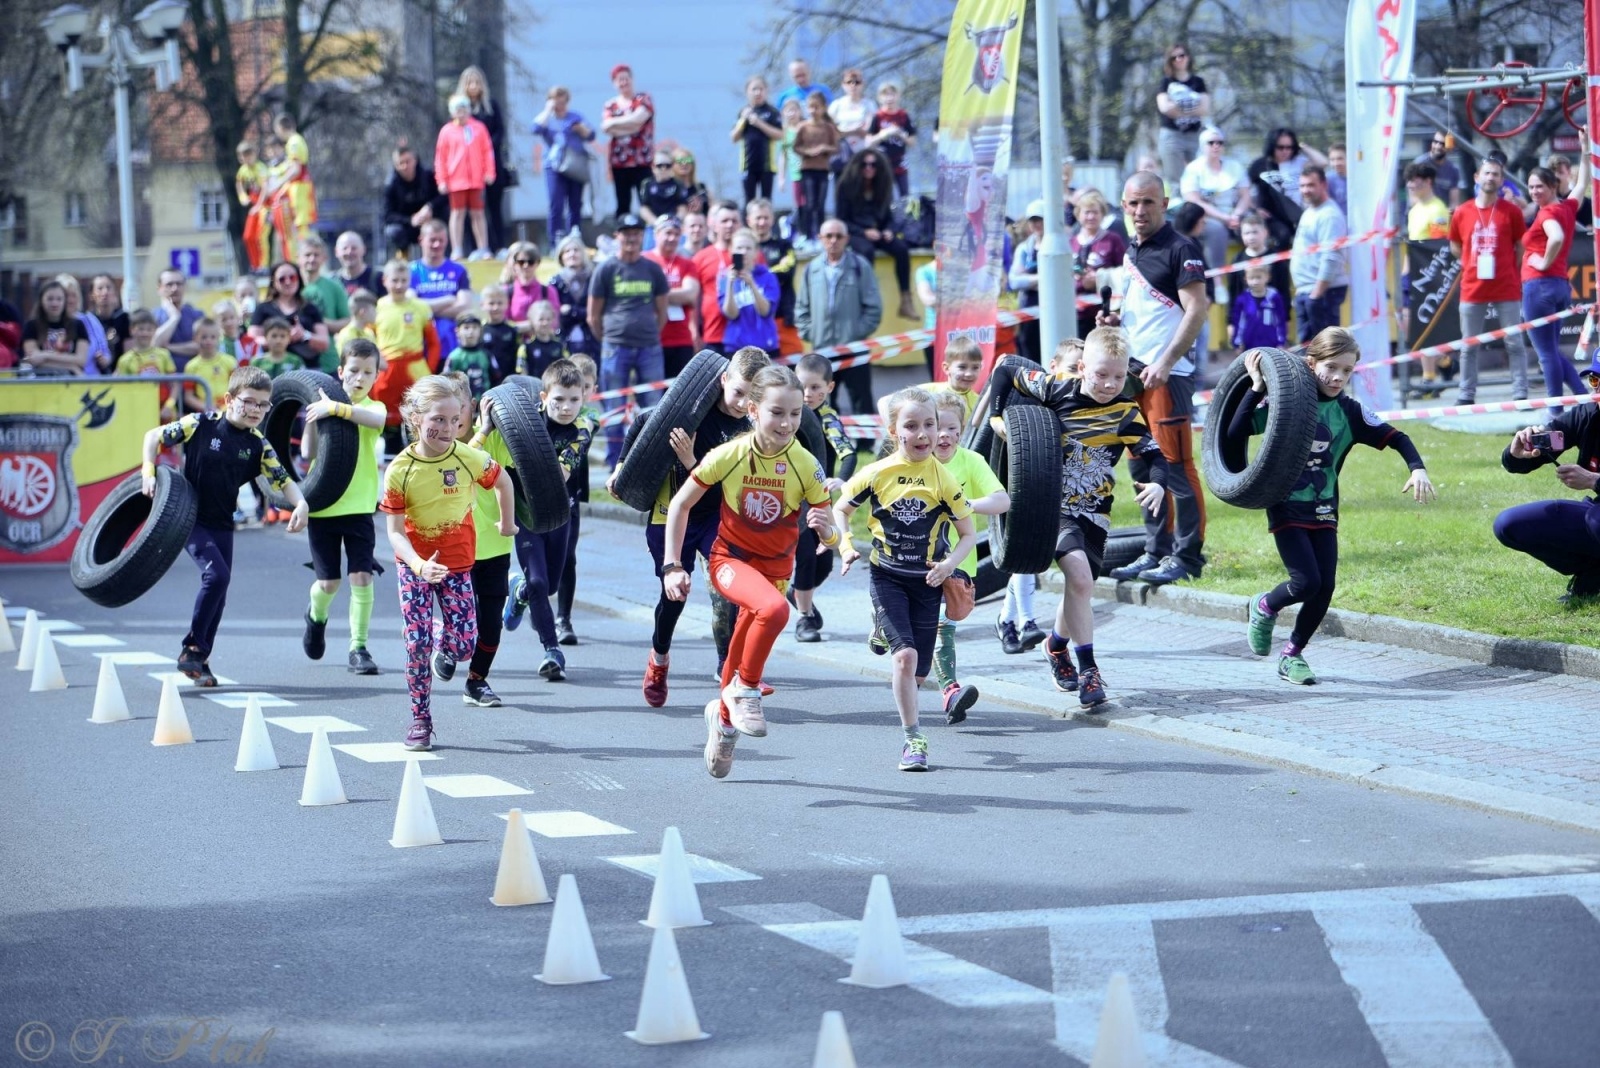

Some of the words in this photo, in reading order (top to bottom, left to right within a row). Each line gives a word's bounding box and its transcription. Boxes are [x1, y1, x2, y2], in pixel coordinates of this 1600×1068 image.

[426, 427, 440, 440] 102
[742, 475, 786, 488] RACIBORKI
[443, 487, 459, 495] NIKA
[8, 521, 43, 542] OCR
